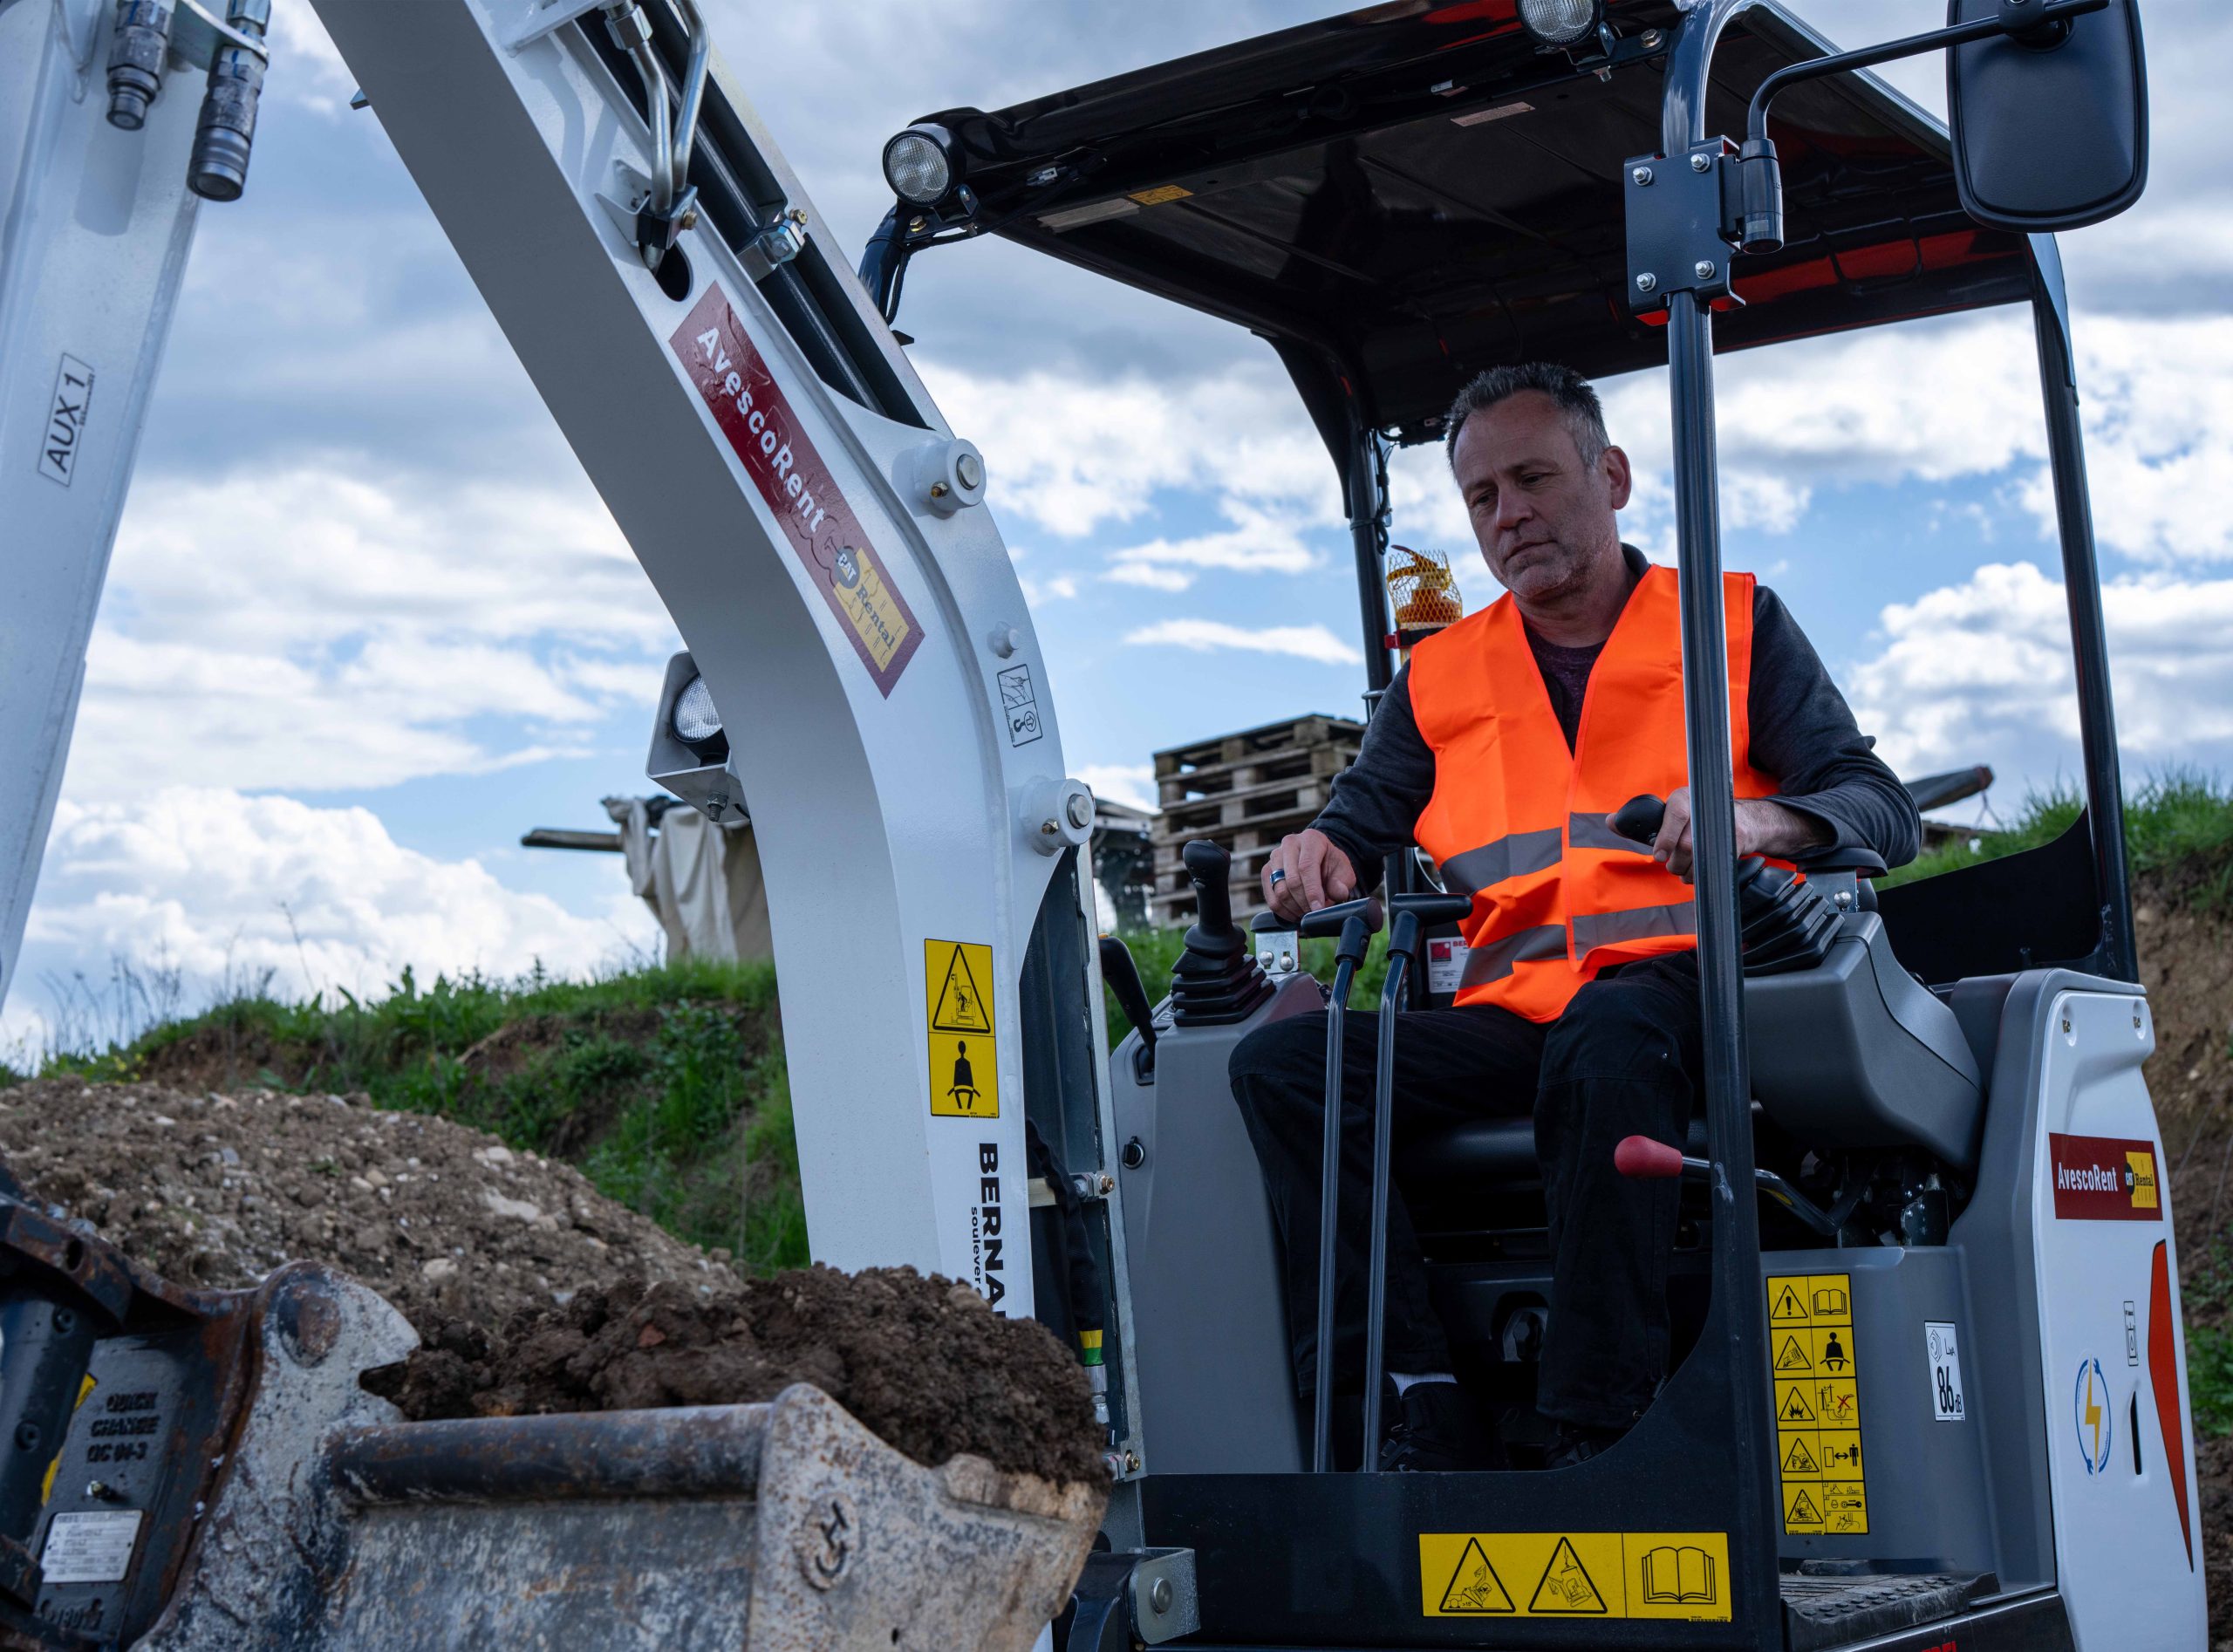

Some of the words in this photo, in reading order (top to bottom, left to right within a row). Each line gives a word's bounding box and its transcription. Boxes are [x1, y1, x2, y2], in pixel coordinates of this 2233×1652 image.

[46, 395, 81, 474] AUX
[64, 372, 85, 388] 1
[696, 326, 825, 535] AvescoRent
[837, 552, 857, 582] CAT
[856, 583, 895, 651] Rental
[2058, 1162, 2119, 1192] AvescoRent
[2134, 1173, 2154, 1187] Rental
[970, 1206, 982, 1286] soulever
[979, 1143, 1007, 1319] BERNA
[106, 1392, 159, 1412] QUICK
[1936, 1366, 1955, 1414] 86
[91, 1416, 159, 1437] CHANGE
